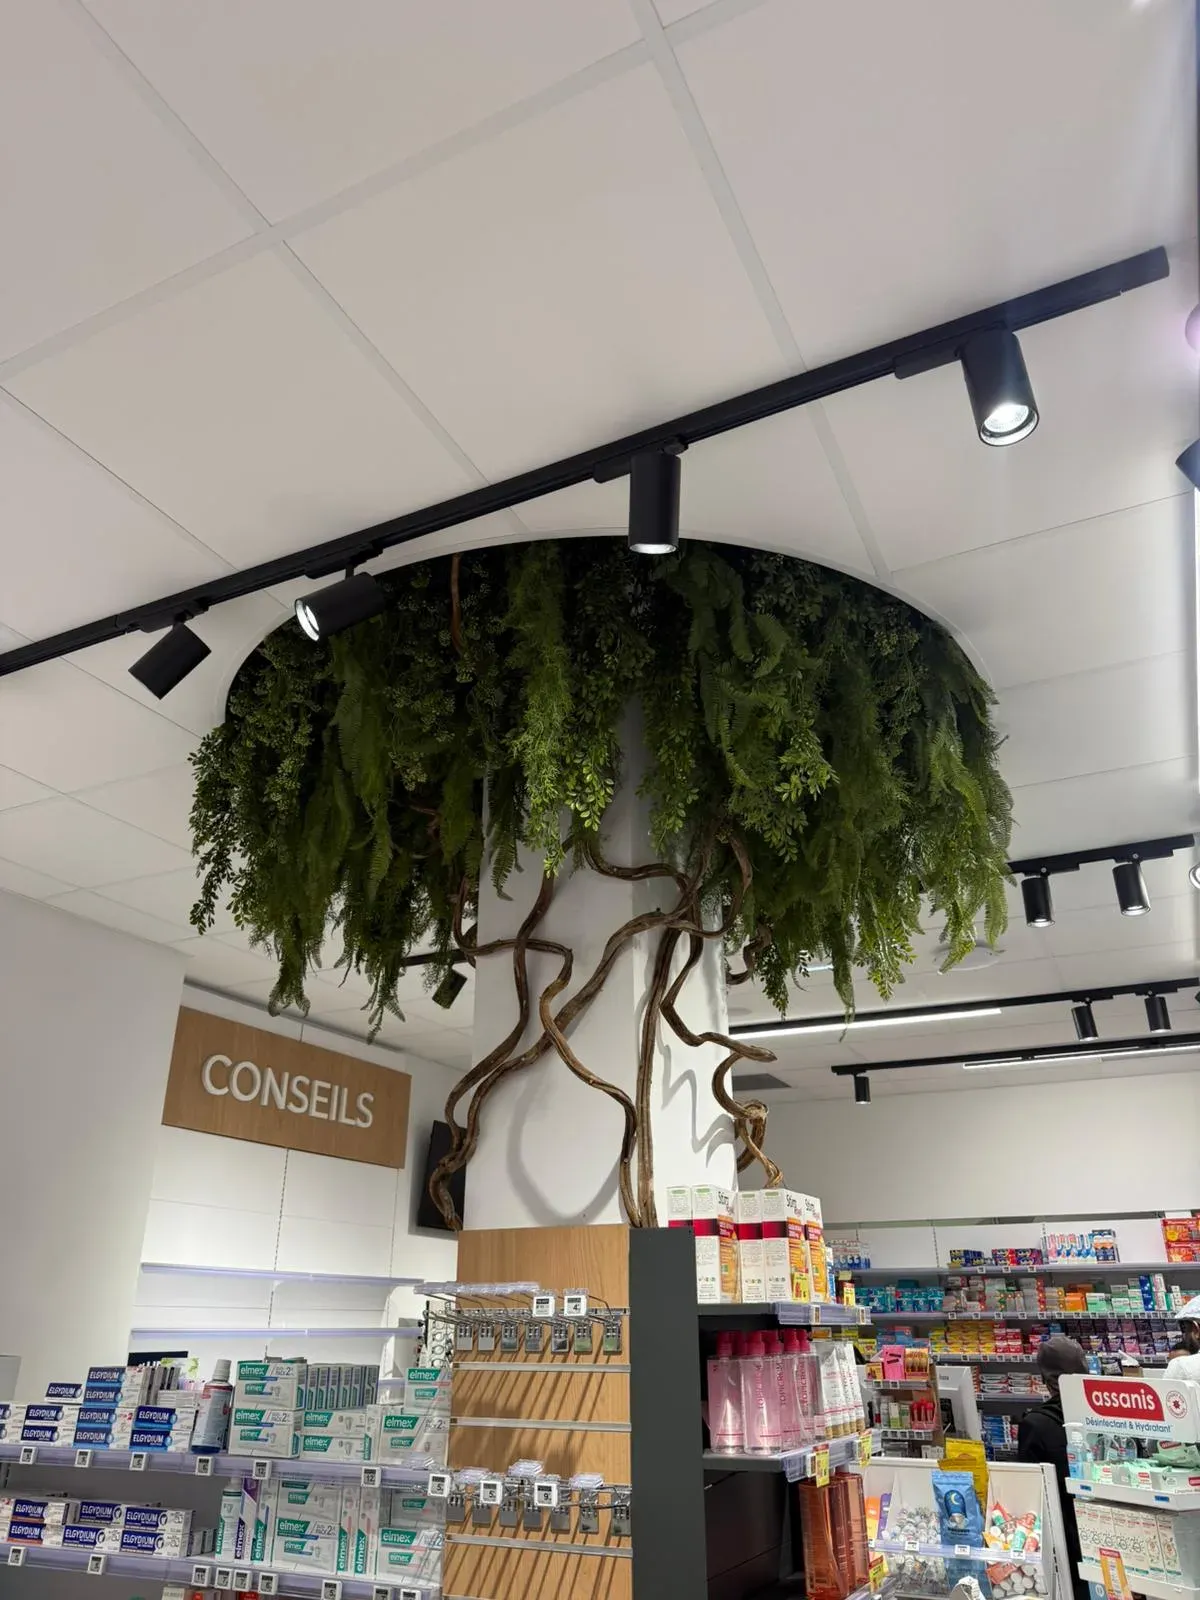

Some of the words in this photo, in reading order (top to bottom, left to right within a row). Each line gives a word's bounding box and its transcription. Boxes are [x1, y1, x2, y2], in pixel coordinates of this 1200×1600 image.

[202, 1054, 374, 1128] CONSEILS
[240, 1365, 265, 1375] elmex
[409, 1370, 435, 1380] elmex
[1091, 1388, 1156, 1411] assanis
[236, 1411, 260, 1421] elmex
[386, 1417, 413, 1428] elmex
[1085, 1417, 1127, 1430] Désinfectant
[1129, 1421, 1134, 1430] &
[279, 1522, 304, 1532] elmex
[236, 1524, 246, 1557] elmex
[255, 1525, 265, 1558] elmex
[383, 1531, 411, 1544] elmex
[338, 1535, 347, 1569] elmex
[357, 1536, 366, 1572] elmex
